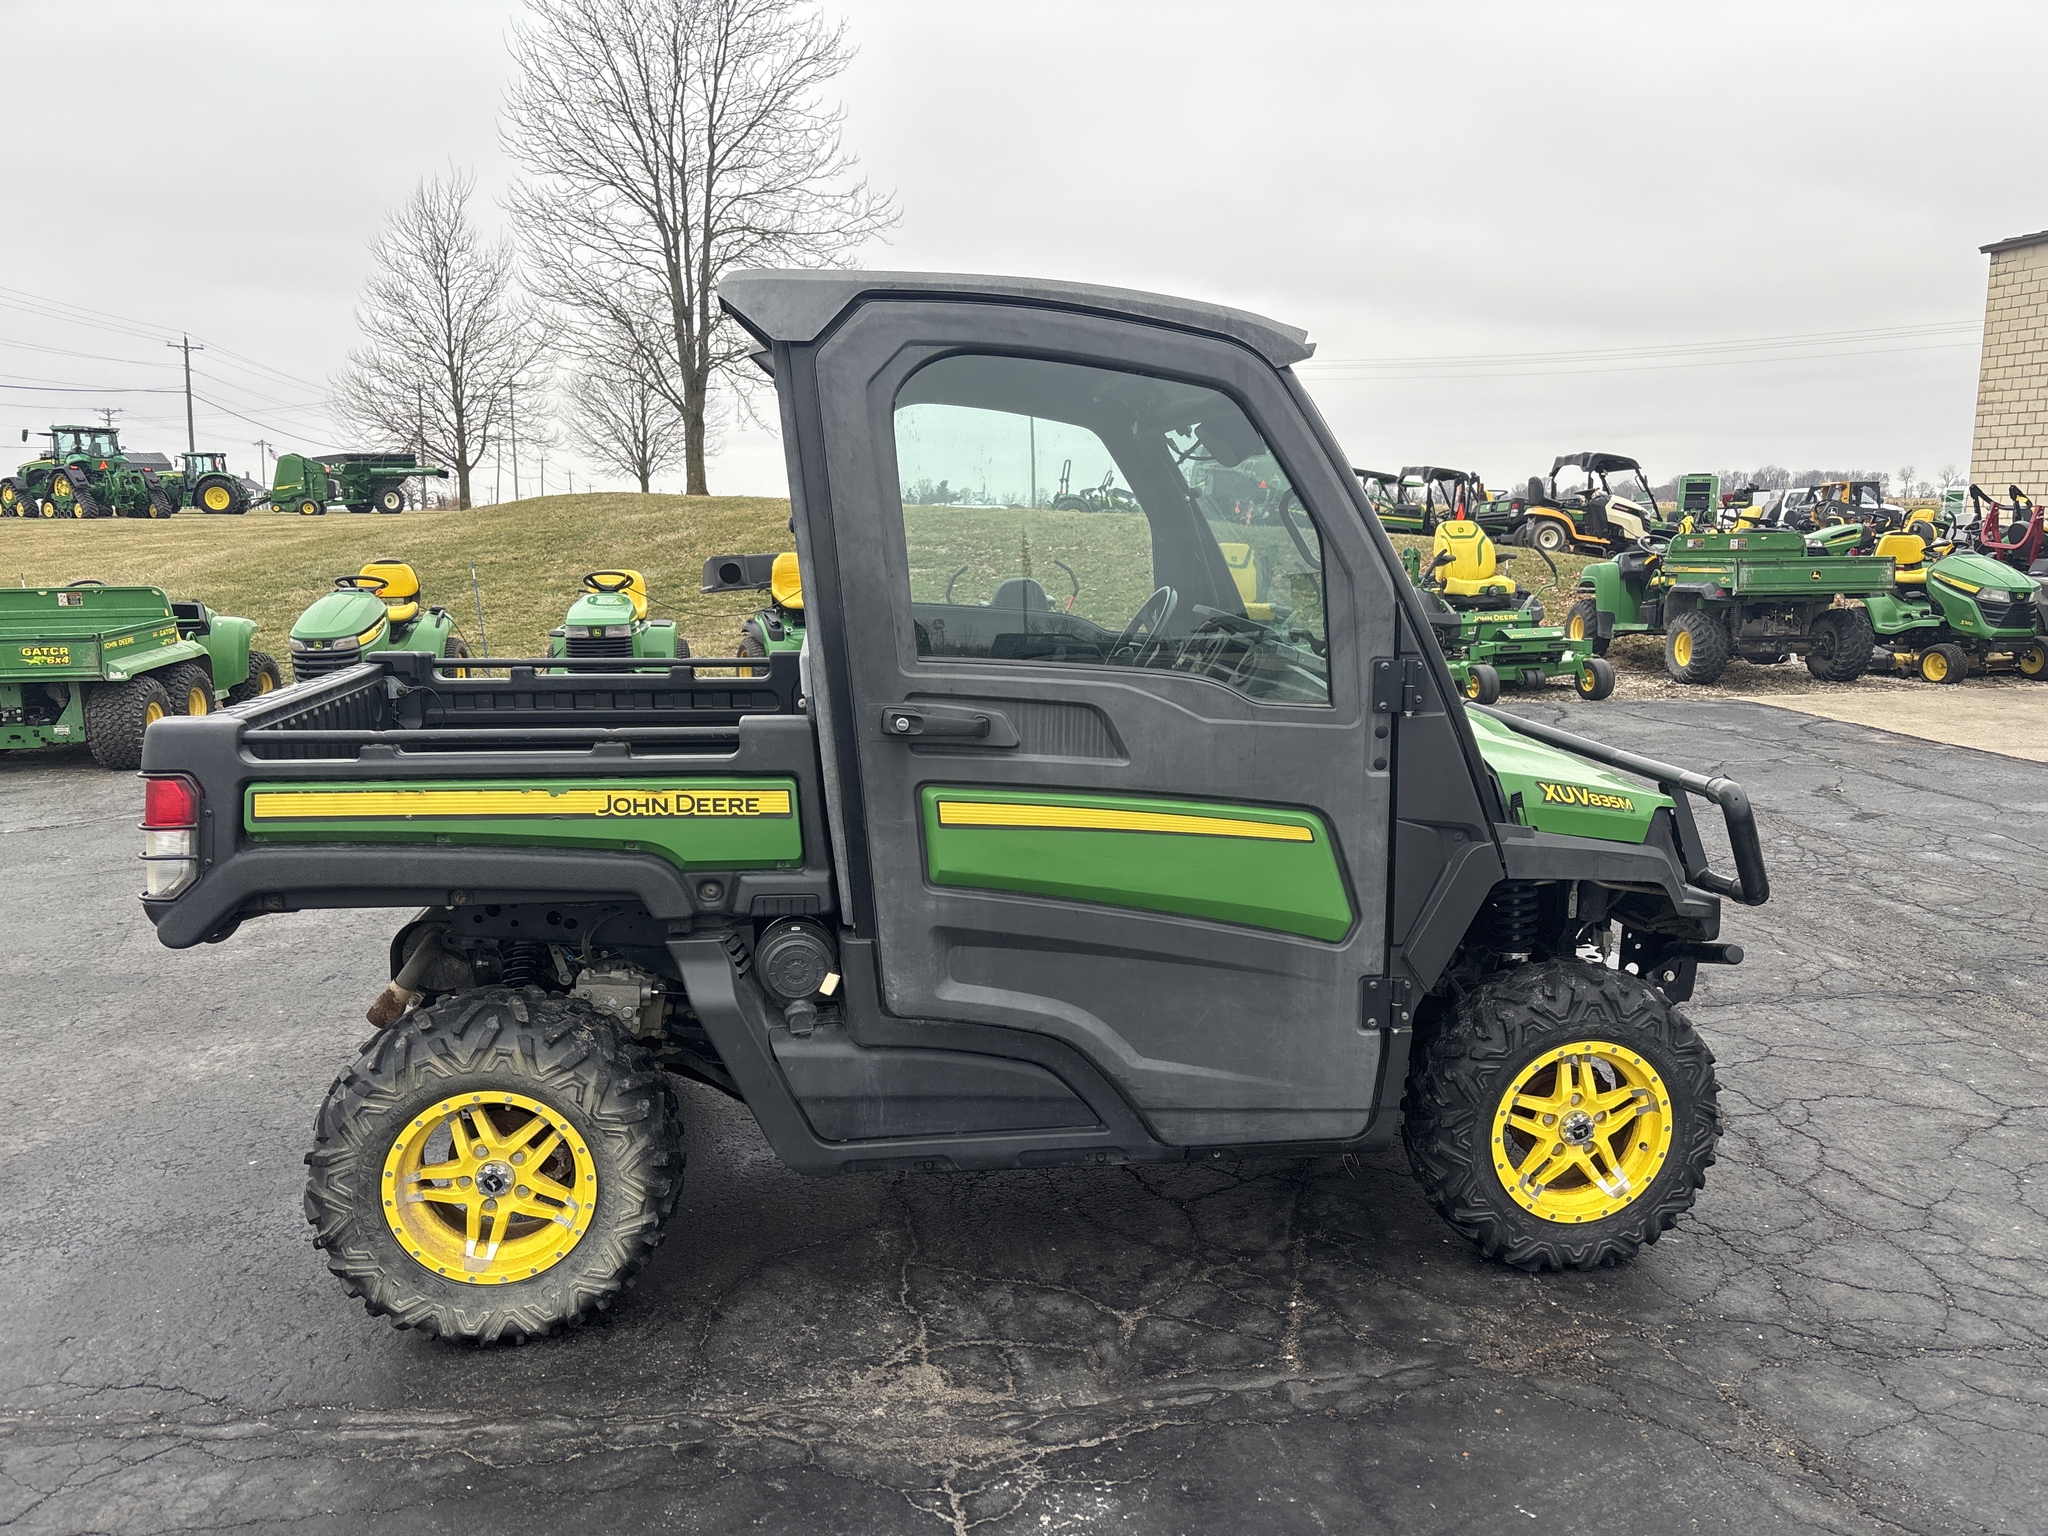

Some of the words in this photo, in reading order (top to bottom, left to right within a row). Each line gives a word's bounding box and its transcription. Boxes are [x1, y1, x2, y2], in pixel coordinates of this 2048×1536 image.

[104, 640, 118, 650] JOHN
[118, 636, 135, 646] DEERE
[46, 655, 69, 664] 6x4
[598, 794, 669, 814] JOHN
[675, 794, 760, 814] DEERE
[1538, 781, 1635, 813] XUV835M
